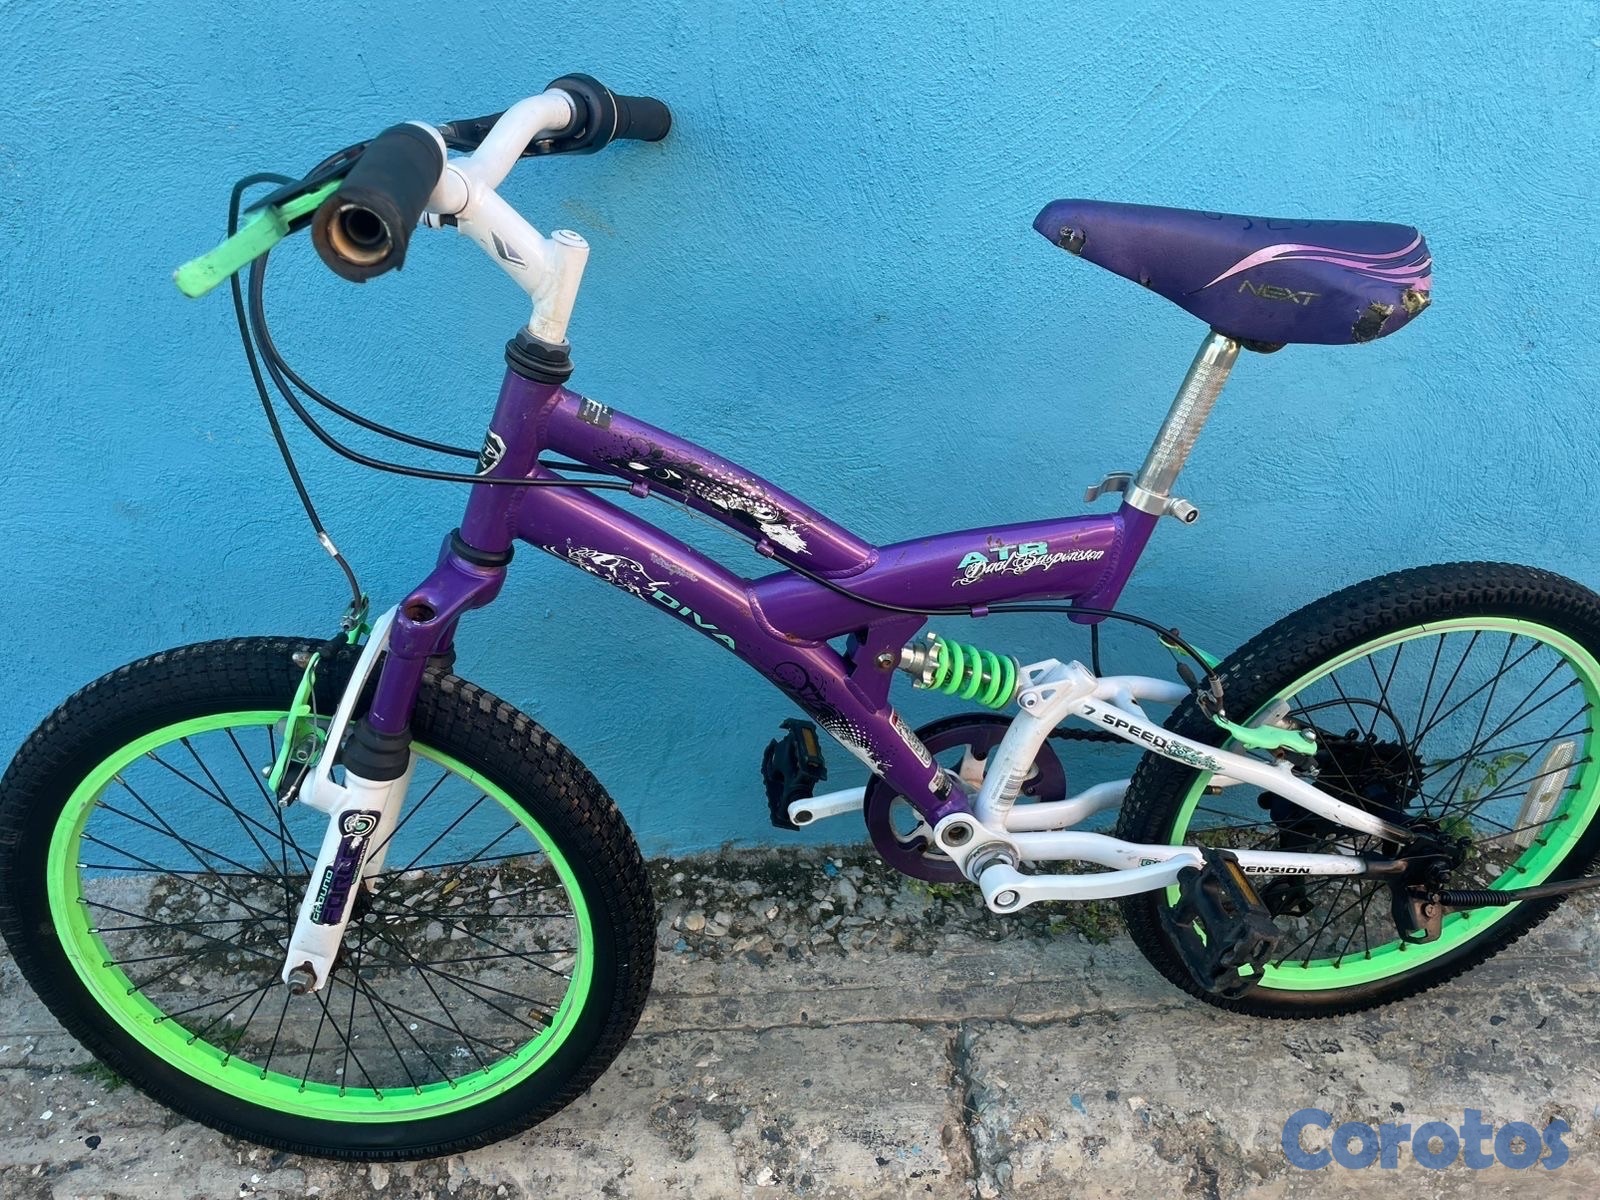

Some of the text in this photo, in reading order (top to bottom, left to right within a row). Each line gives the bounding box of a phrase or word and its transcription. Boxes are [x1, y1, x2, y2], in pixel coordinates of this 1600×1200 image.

[1238, 280, 1322, 306] NEXT
[957, 541, 1048, 570] ATB
[652, 590, 736, 650] DIVA
[1083, 704, 1168, 749] 7 SPEED
